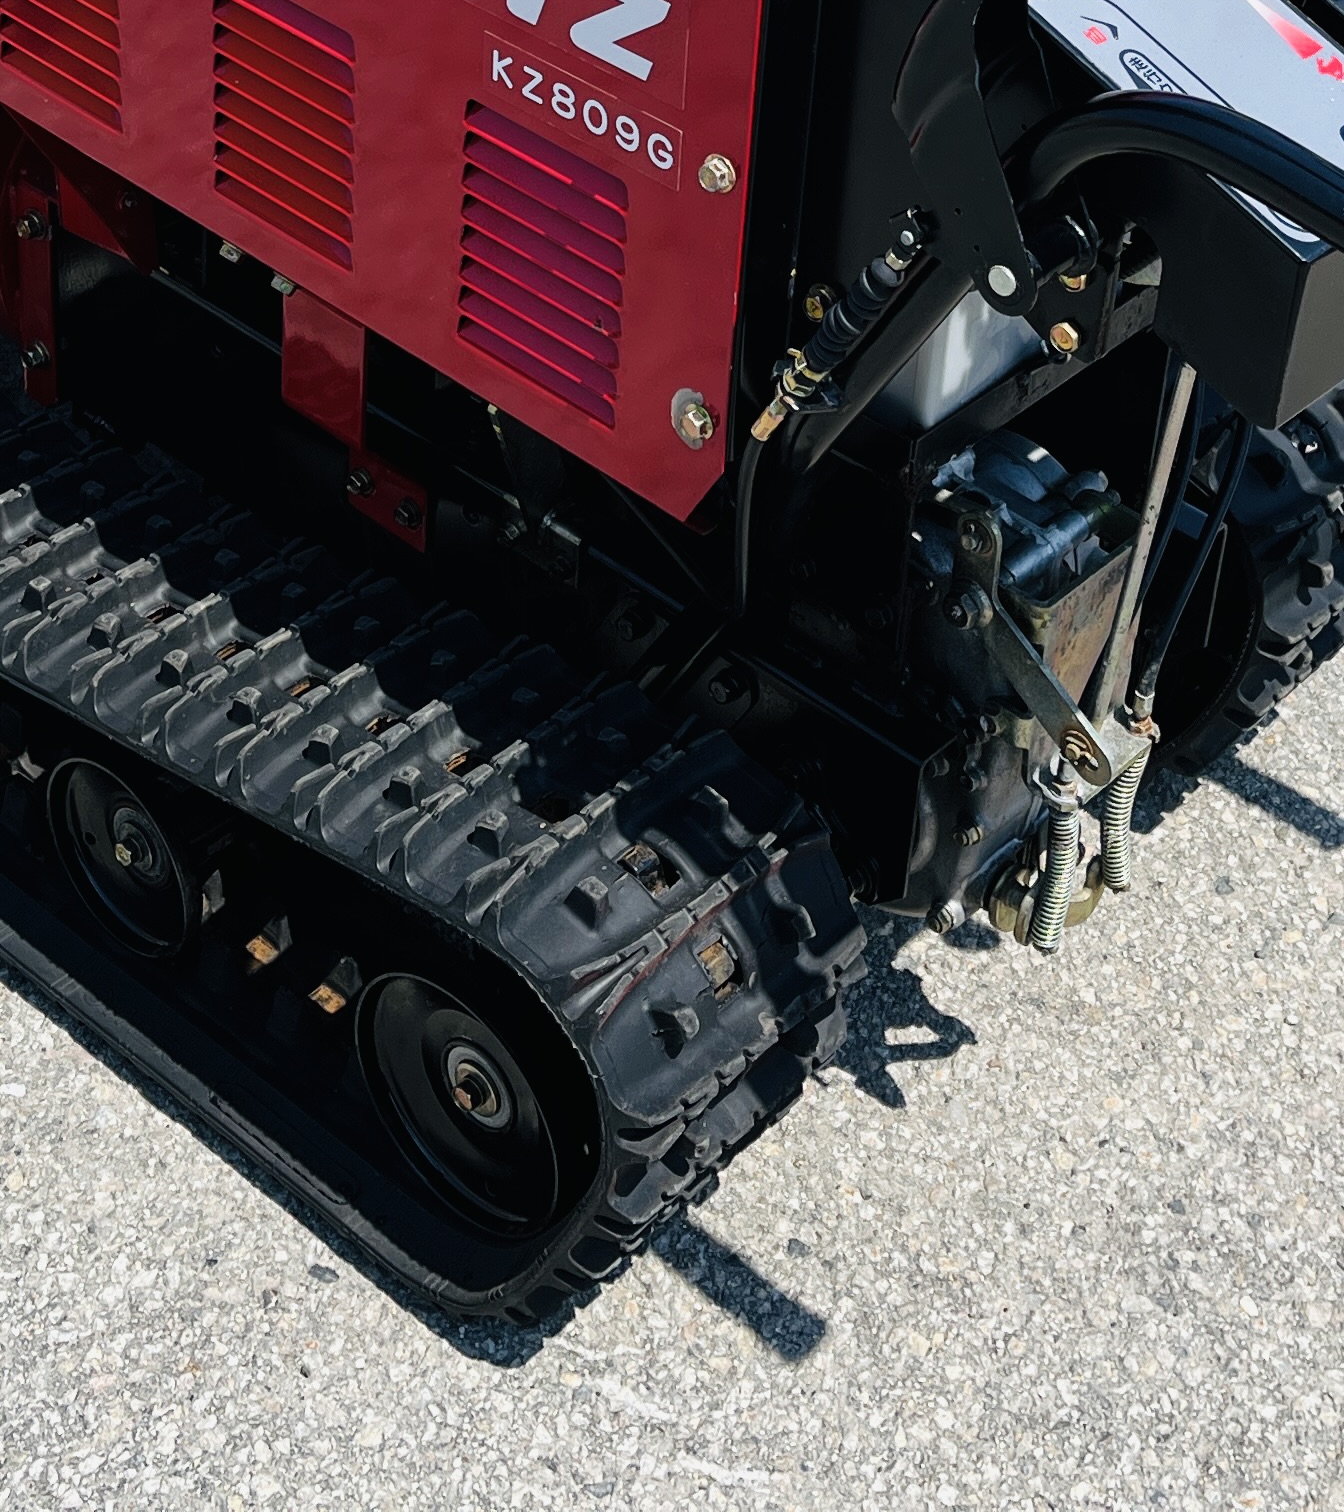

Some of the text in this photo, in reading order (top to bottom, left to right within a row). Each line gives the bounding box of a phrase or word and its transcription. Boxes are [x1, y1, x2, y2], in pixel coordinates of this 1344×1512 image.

[490, 47, 675, 171] KZ809G
[1128, 56, 1174, 93] 走行ク
